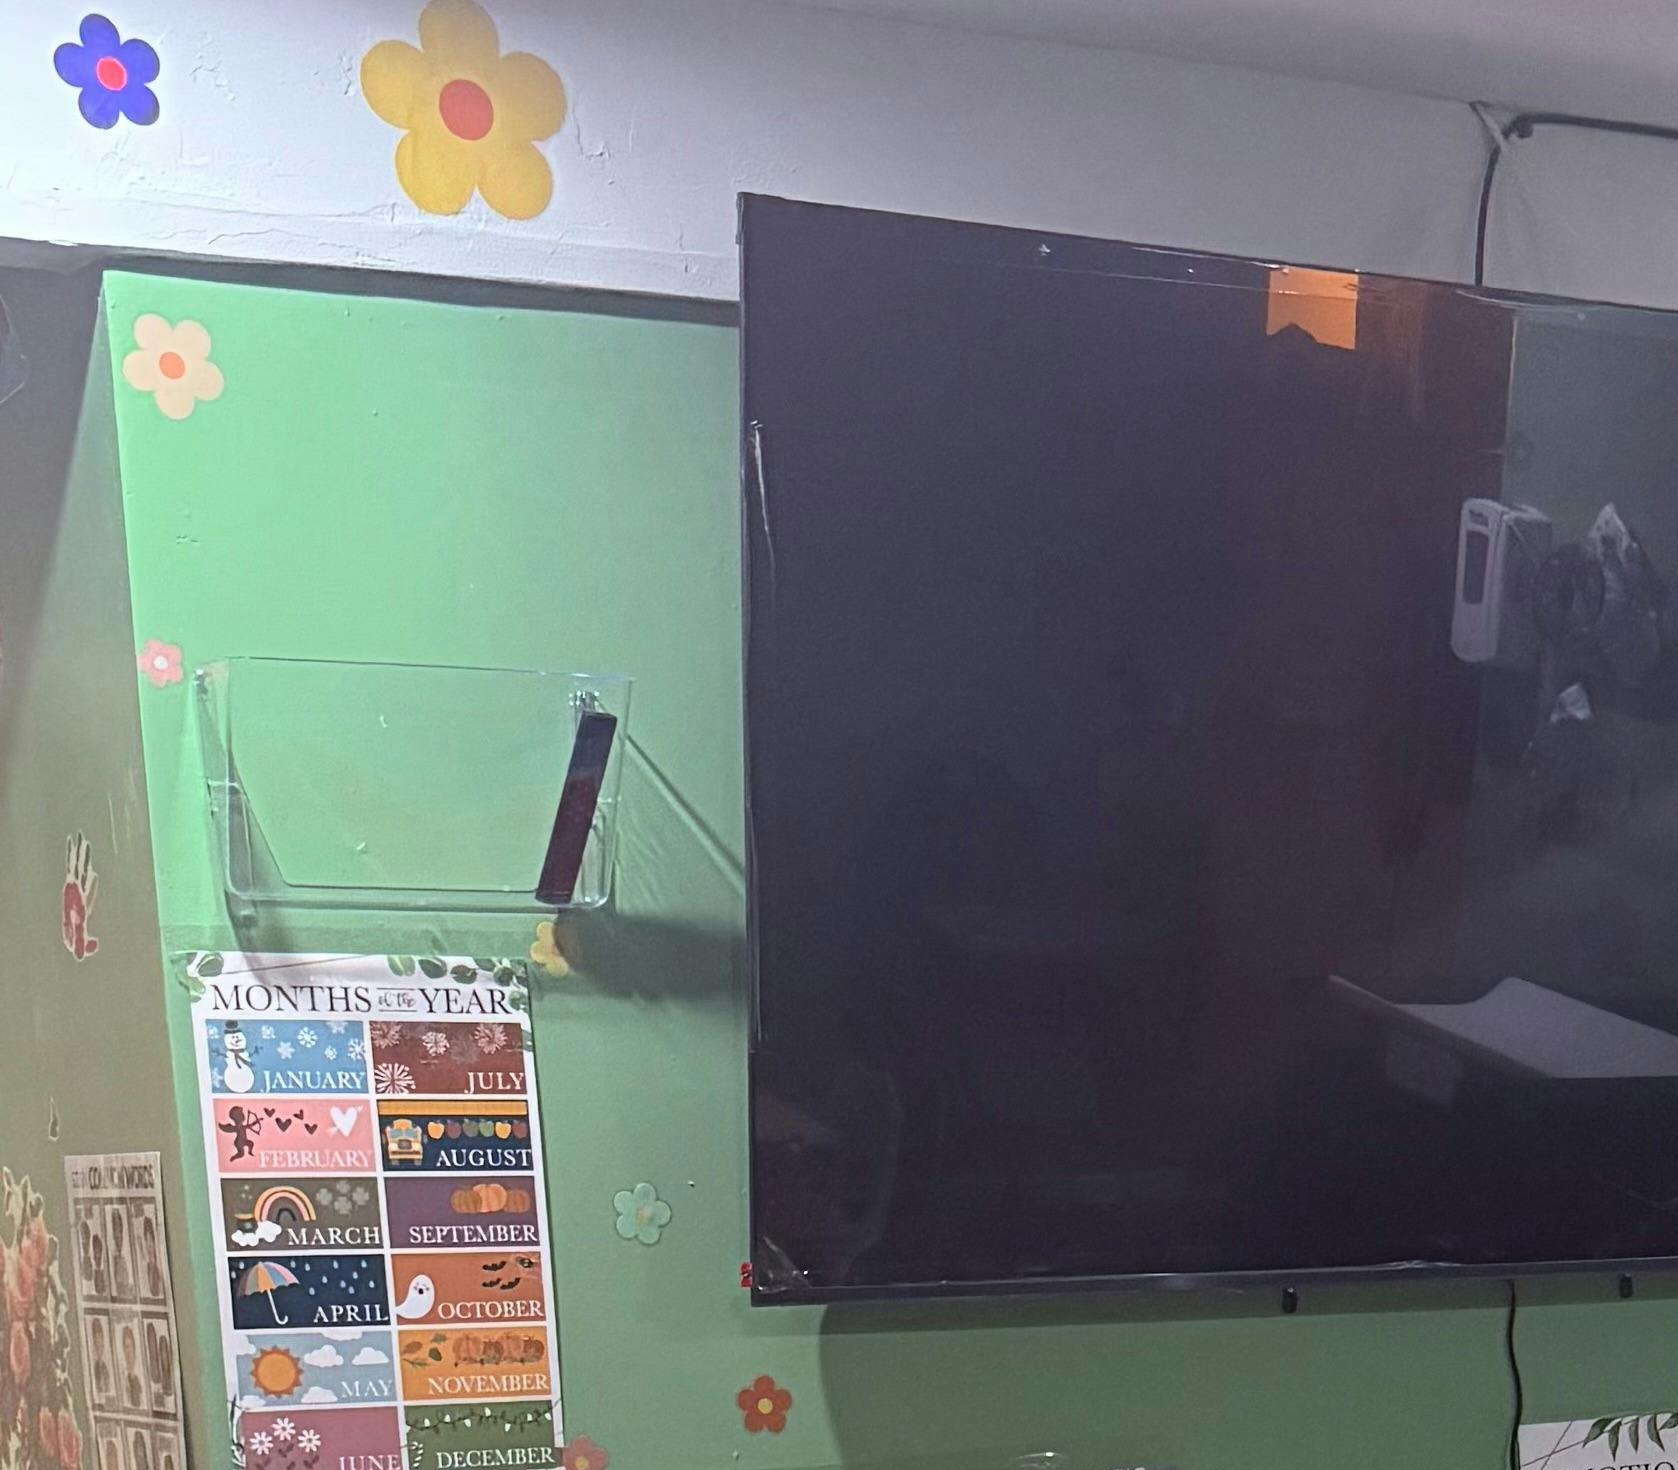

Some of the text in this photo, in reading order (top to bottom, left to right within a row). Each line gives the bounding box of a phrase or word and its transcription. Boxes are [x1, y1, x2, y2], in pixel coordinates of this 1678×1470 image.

[212, 984, 372, 1014] MONTHS
[417, 987, 512, 1015] YEAR
[260, 1070, 366, 1092] JANUARY
[464, 1071, 525, 1094] JULY
[258, 1149, 372, 1169] FEBRUARY
[436, 1148, 532, 1168] AUGUST
[288, 1226, 381, 1246] MARCH
[409, 1223, 538, 1244] SEPTEMBER
[313, 1303, 389, 1324] APRIL
[438, 1300, 544, 1320] OCTOBER
[340, 1378, 393, 1400] MAY
[428, 1373, 549, 1395] NOVEMBER
[436, 1446, 556, 1470] DECEMBER
